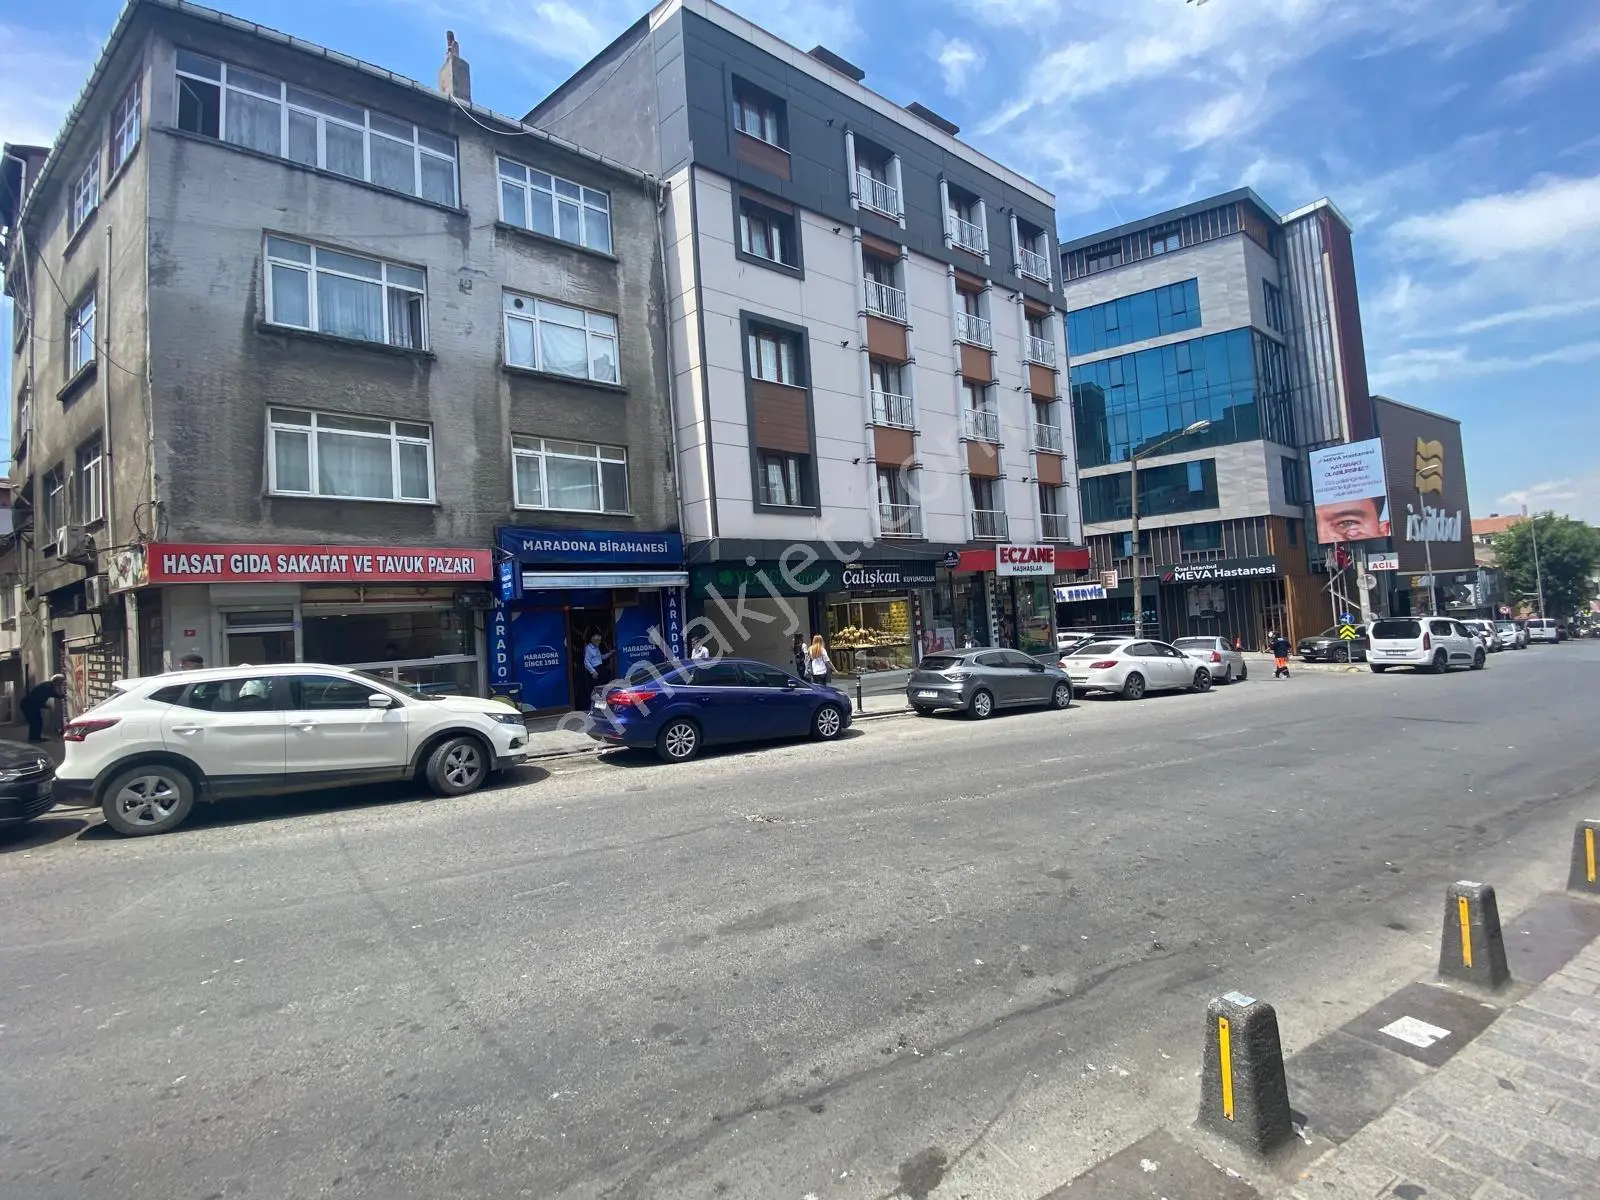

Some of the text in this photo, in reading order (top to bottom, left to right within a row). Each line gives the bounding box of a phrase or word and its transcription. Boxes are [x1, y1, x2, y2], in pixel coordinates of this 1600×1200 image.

[522, 539, 668, 553] MARADONA BİRAHANESİ
[999, 547, 1055, 564] ECZANE
[163, 554, 475, 575] HASAT GIDA SAKATAT VE TAVUK PAZARI
[1012, 564, 1043, 573] HAŞHAŞLAR
[1372, 561, 1395, 569] ACİL
[842, 569, 900, 589] Çalışkan
[1174, 564, 1276, 581] MEVA Hastanesi
[523, 651, 559, 661] MARADONA
